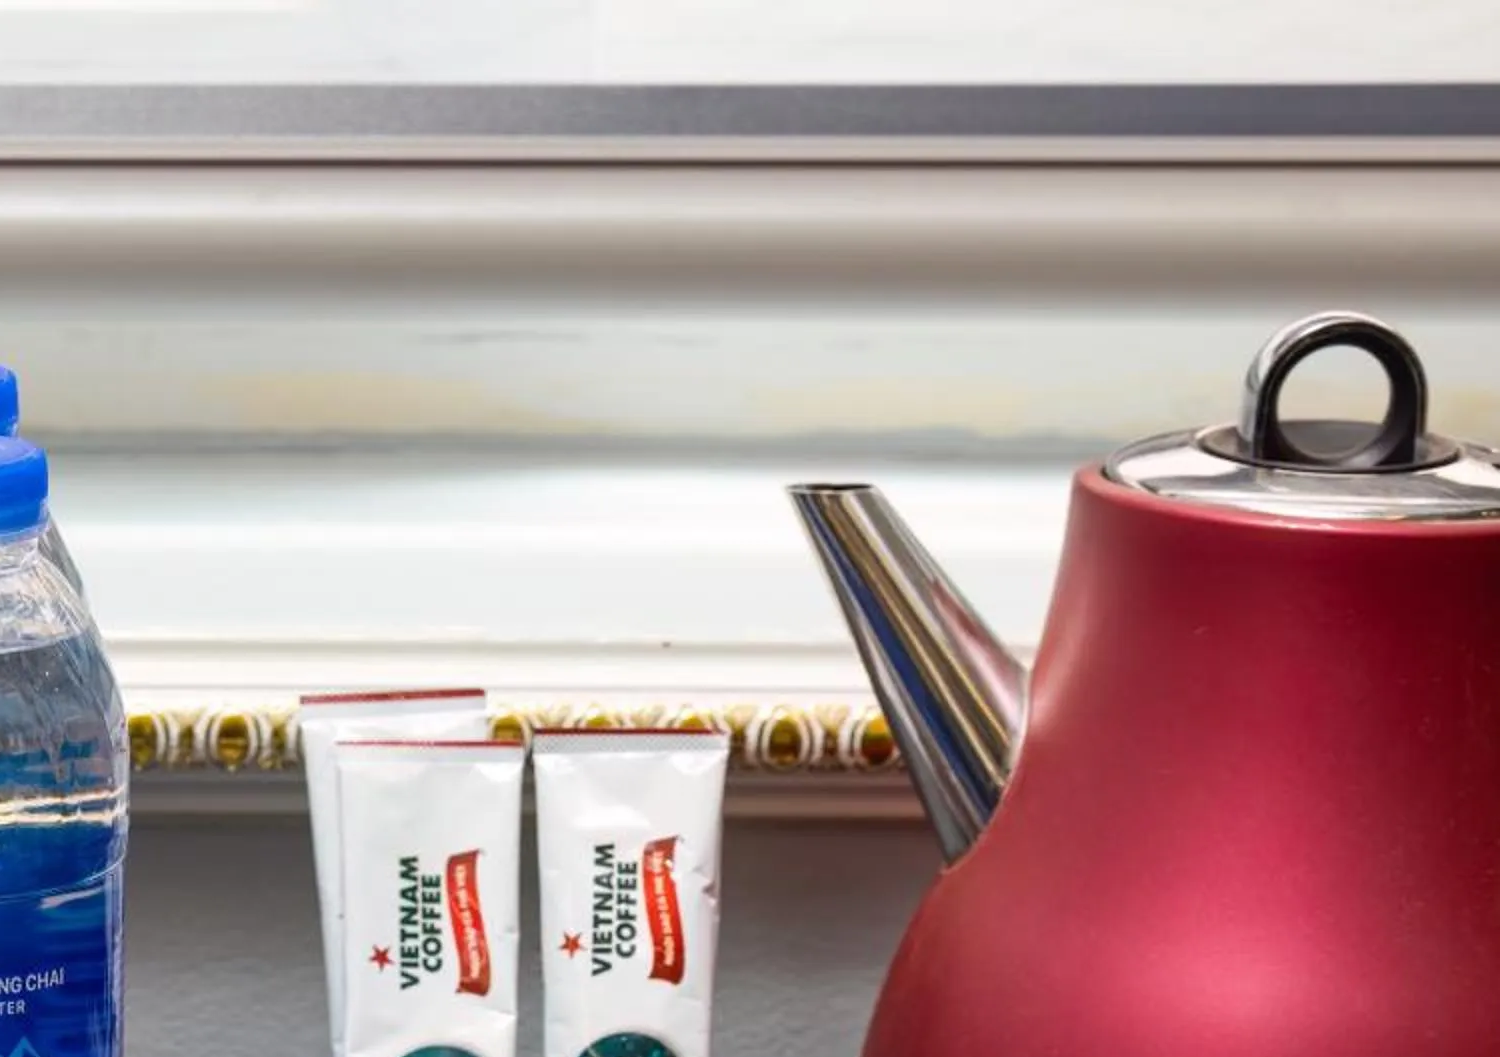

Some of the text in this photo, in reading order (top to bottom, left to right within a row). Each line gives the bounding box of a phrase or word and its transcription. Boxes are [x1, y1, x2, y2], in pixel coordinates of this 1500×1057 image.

[399, 855, 420, 990] VIETNAM
[421, 874, 443, 973] COFFEE
[591, 842, 616, 977] VIETNAM
[615, 861, 638, 959] COFFEE
[25, 966, 65, 992] CHAI
